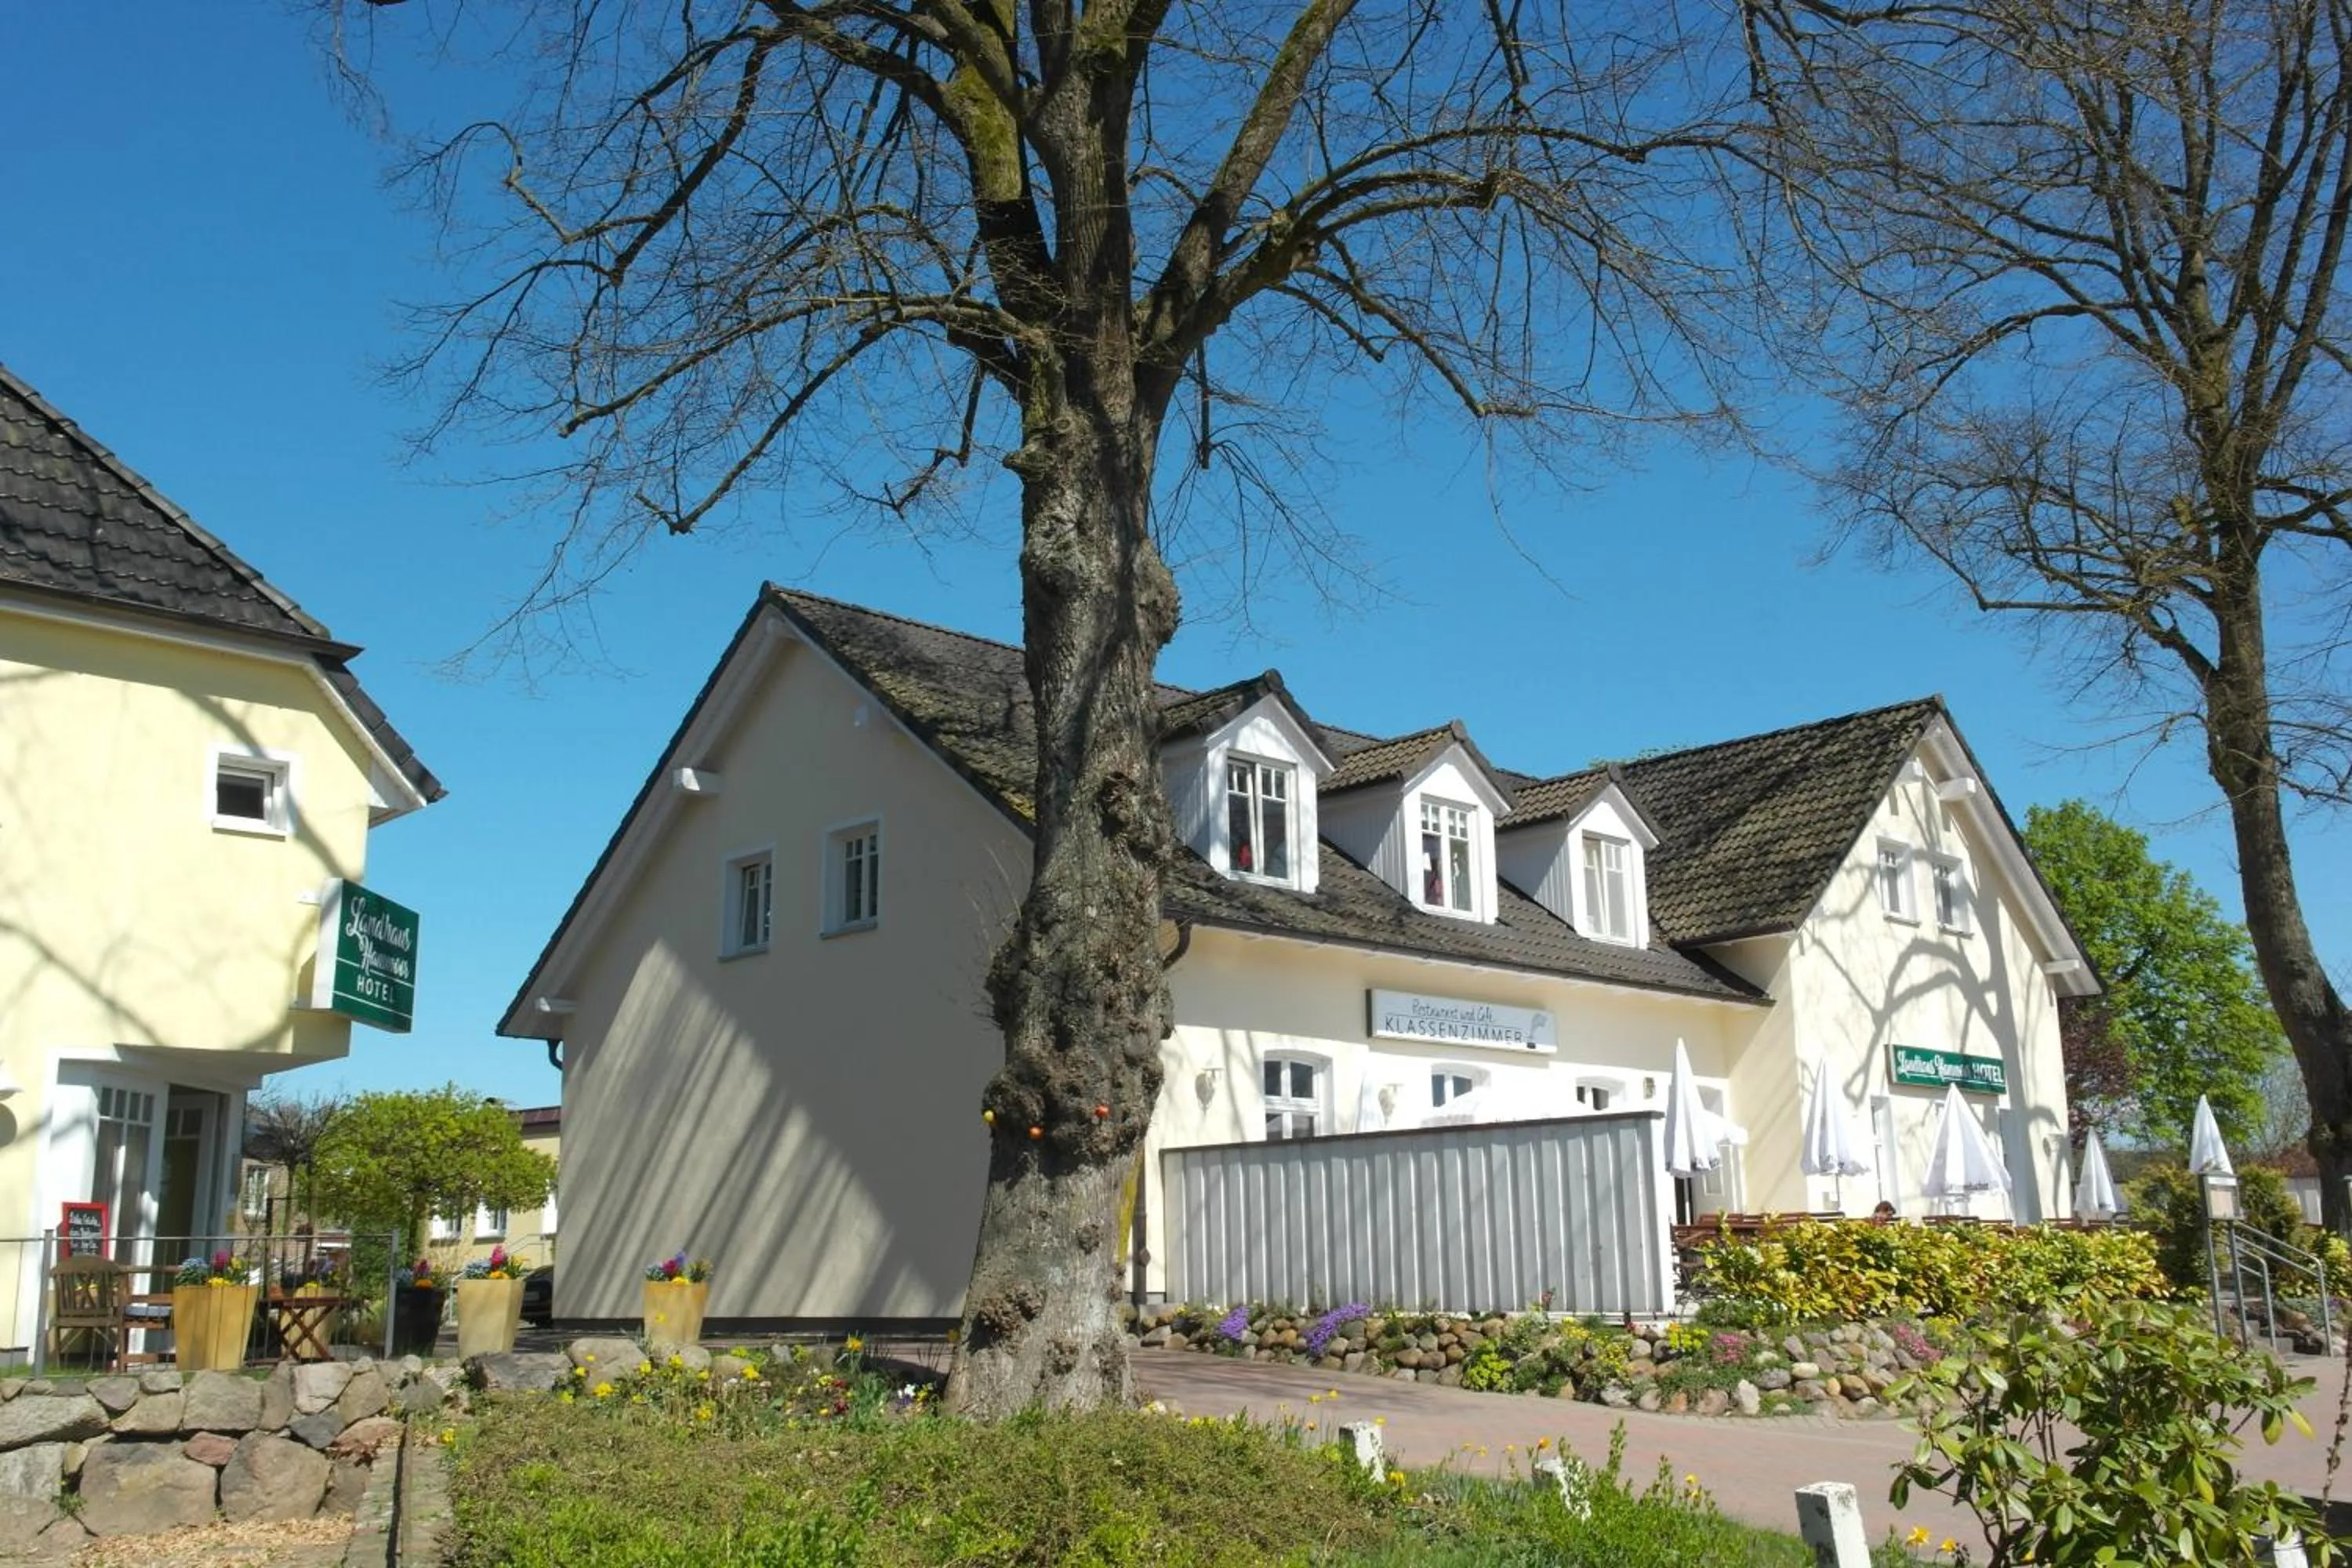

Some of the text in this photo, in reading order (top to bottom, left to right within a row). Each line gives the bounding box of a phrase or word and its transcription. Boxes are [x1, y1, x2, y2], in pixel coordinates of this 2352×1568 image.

[346, 897, 411, 951] Landhaus
[357, 975, 394, 1003] HOTEL
[1385, 1017, 1523, 1044] KLASSENZIMMER
[1972, 1062, 2003, 1083] HOTEL
